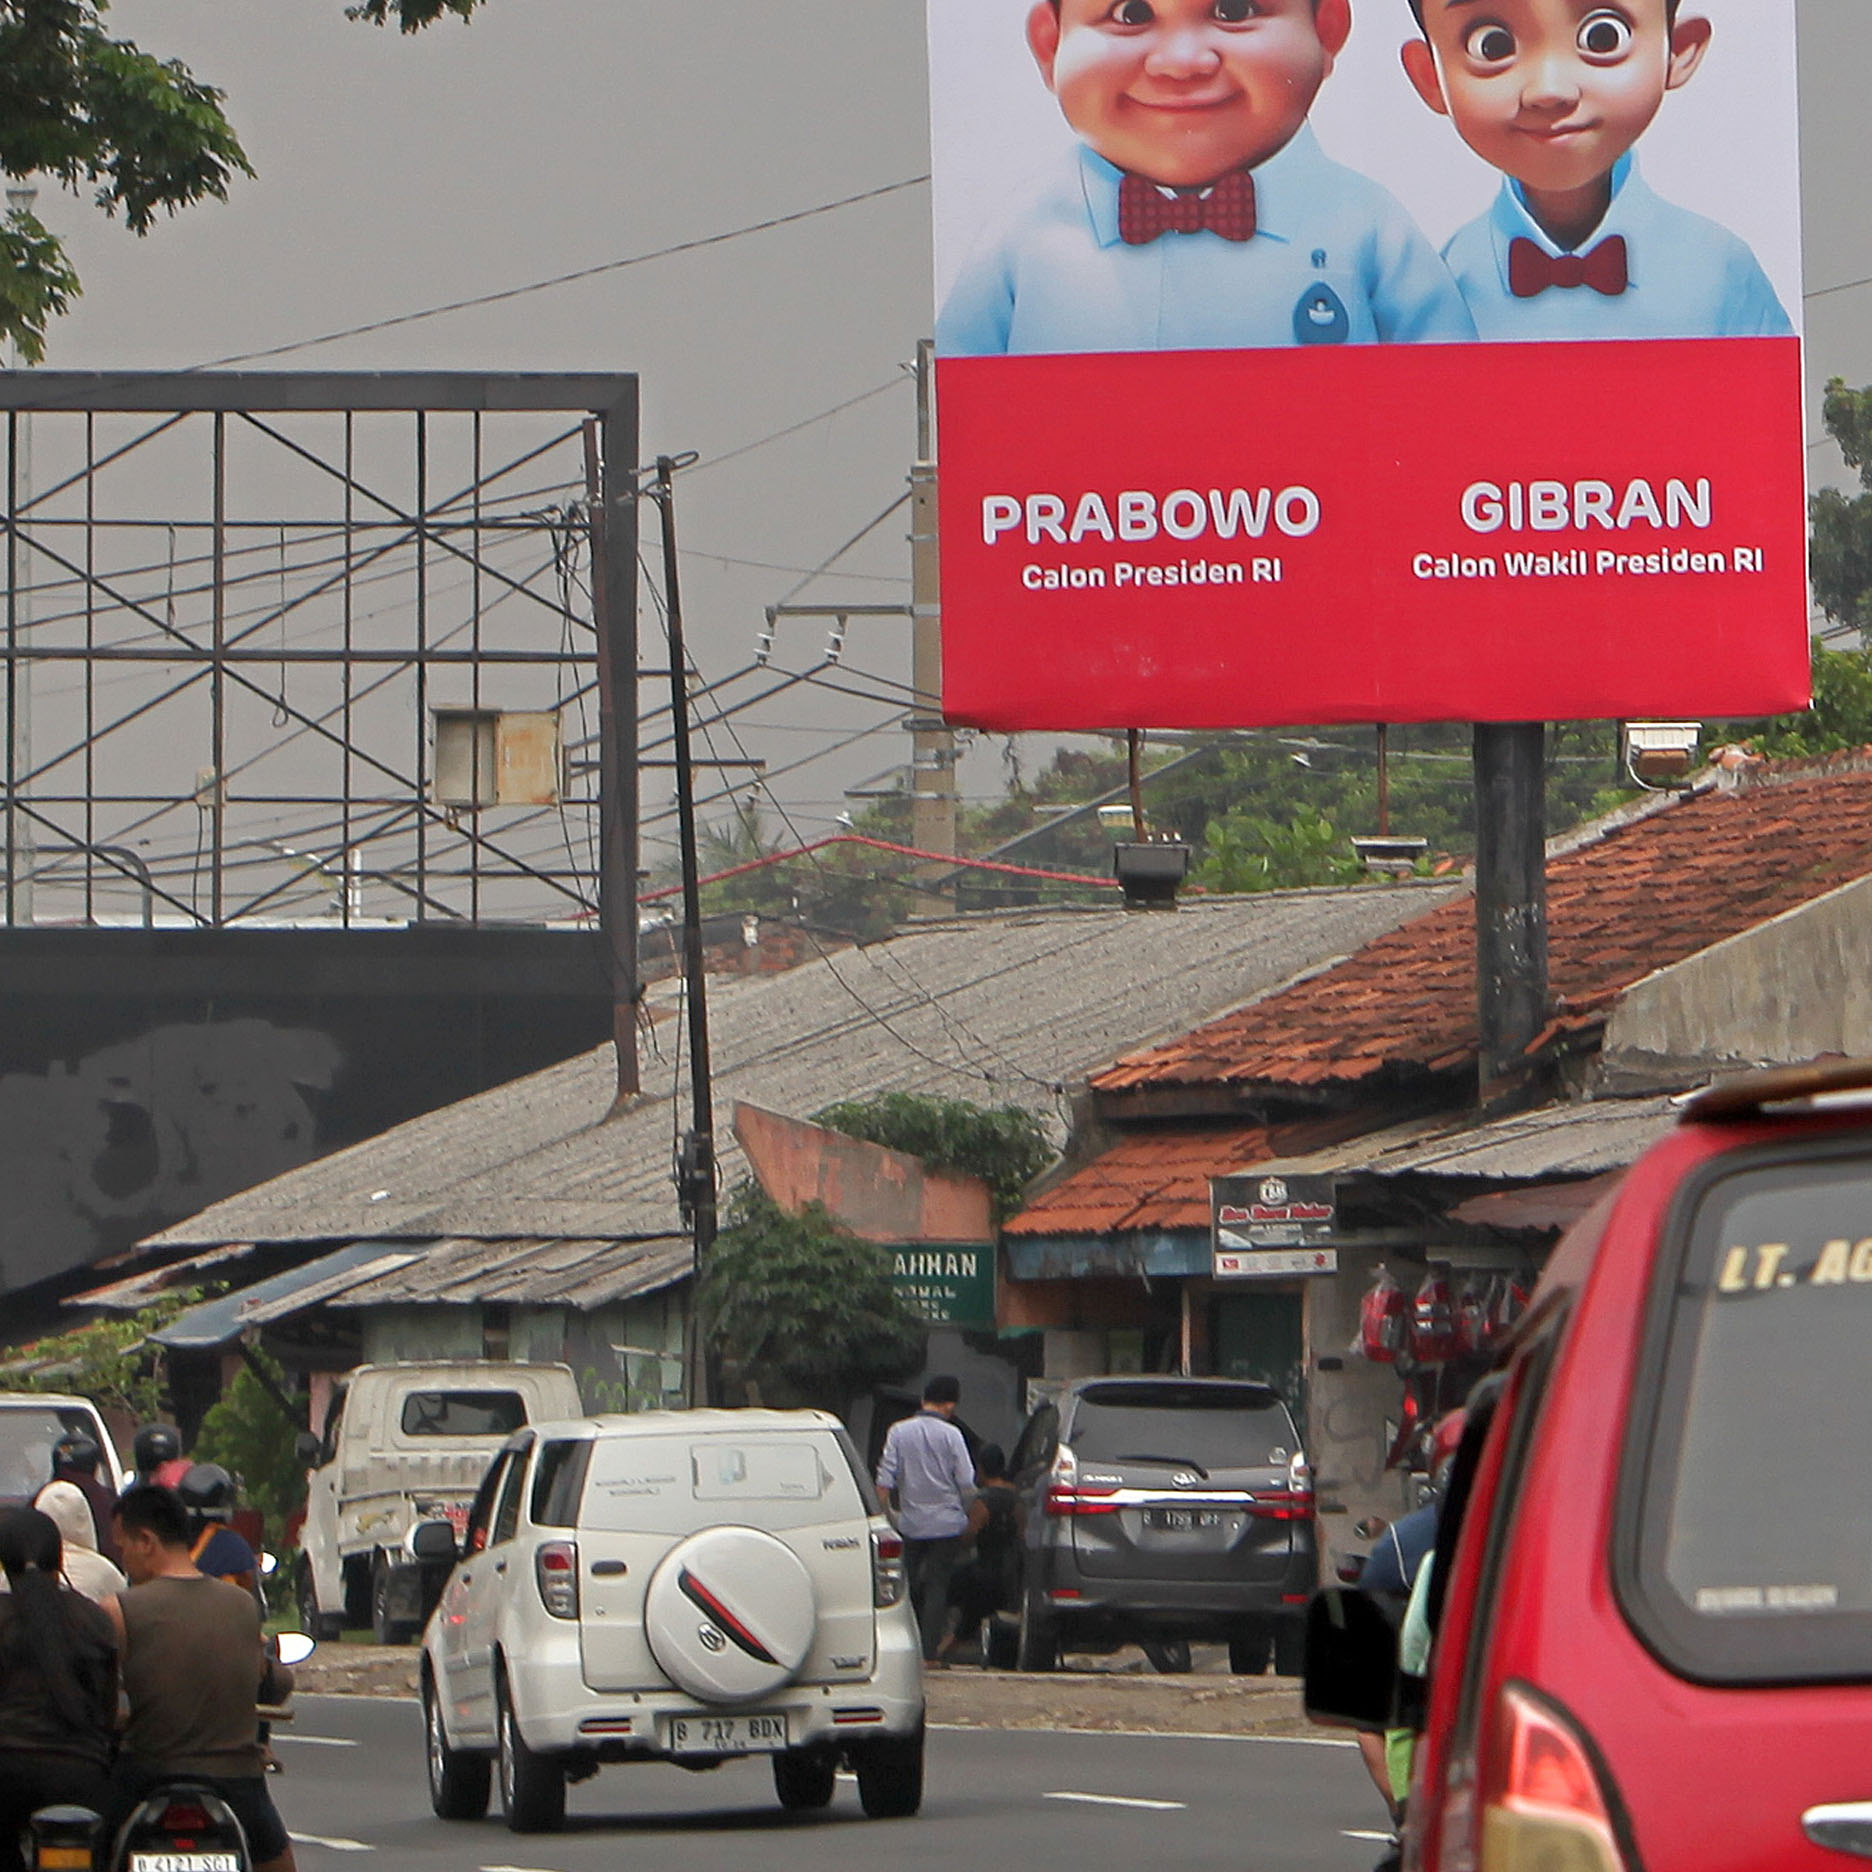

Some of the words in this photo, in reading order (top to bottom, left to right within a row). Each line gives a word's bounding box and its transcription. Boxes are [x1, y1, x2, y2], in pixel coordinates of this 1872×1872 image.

[981, 485, 1323, 546] PRABOWO
[1459, 477, 1714, 535] GIBRAN
[1021, 565, 1108, 591] Calon
[1114, 559, 1246, 589] Presiden
[1252, 557, 1284, 584] RI
[1412, 552, 1499, 580] Calon
[1503, 548, 1590, 578] Wakil
[1595, 546, 1728, 576] Presiden
[1733, 547, 1766, 574] RI
[893, 1251, 977, 1277] AHMAN
[1717, 1244, 1796, 1293] LT.
